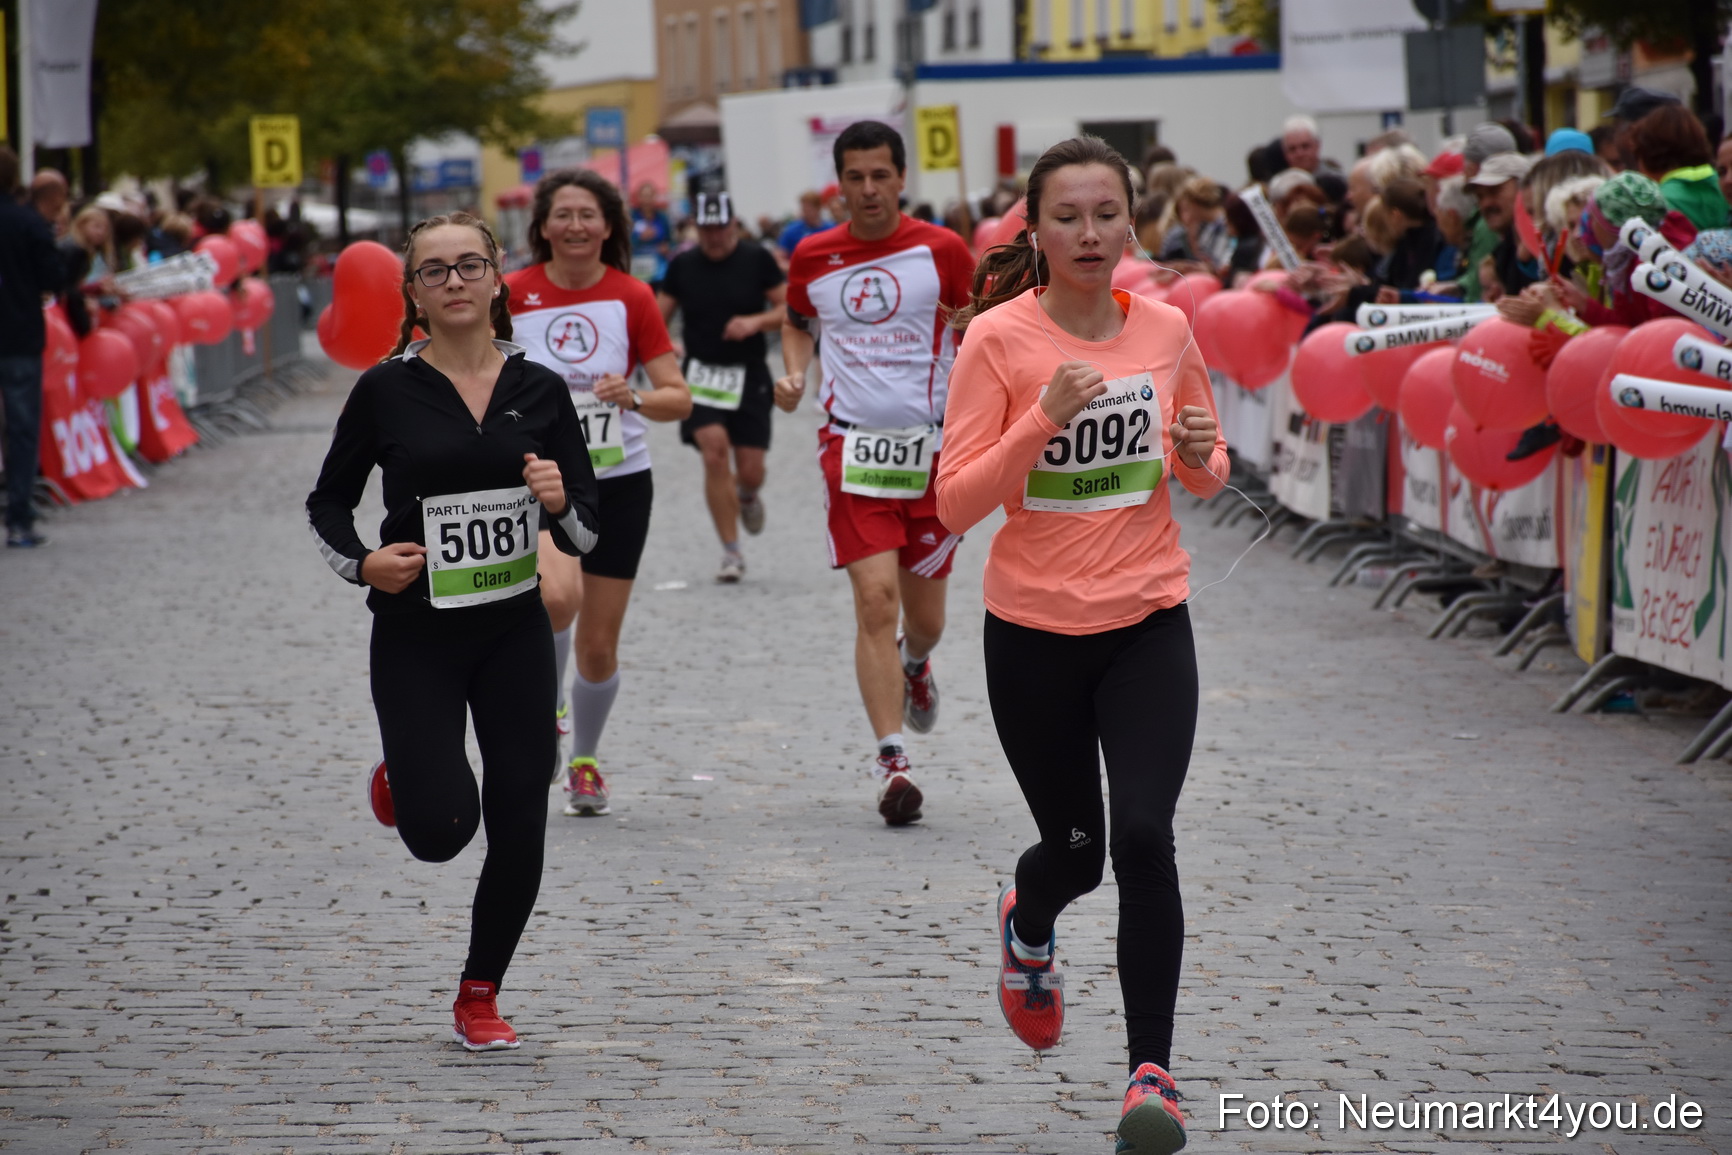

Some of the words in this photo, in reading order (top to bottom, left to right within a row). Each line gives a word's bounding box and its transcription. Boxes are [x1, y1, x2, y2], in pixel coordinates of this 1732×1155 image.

[265, 138, 289, 172] D
[928, 125, 952, 158] D
[1386, 328, 1428, 348] BMW
[1433, 321, 1475, 341] Lauf
[854, 436, 924, 466] 5051
[1044, 408, 1151, 466] 5092
[860, 472, 912, 487] Johannes
[1072, 472, 1121, 496] Sarah
[427, 505, 469, 517] PARTL
[472, 498, 526, 514] Neumarkt
[440, 510, 529, 564] 5081
[473, 570, 511, 589] Clara
